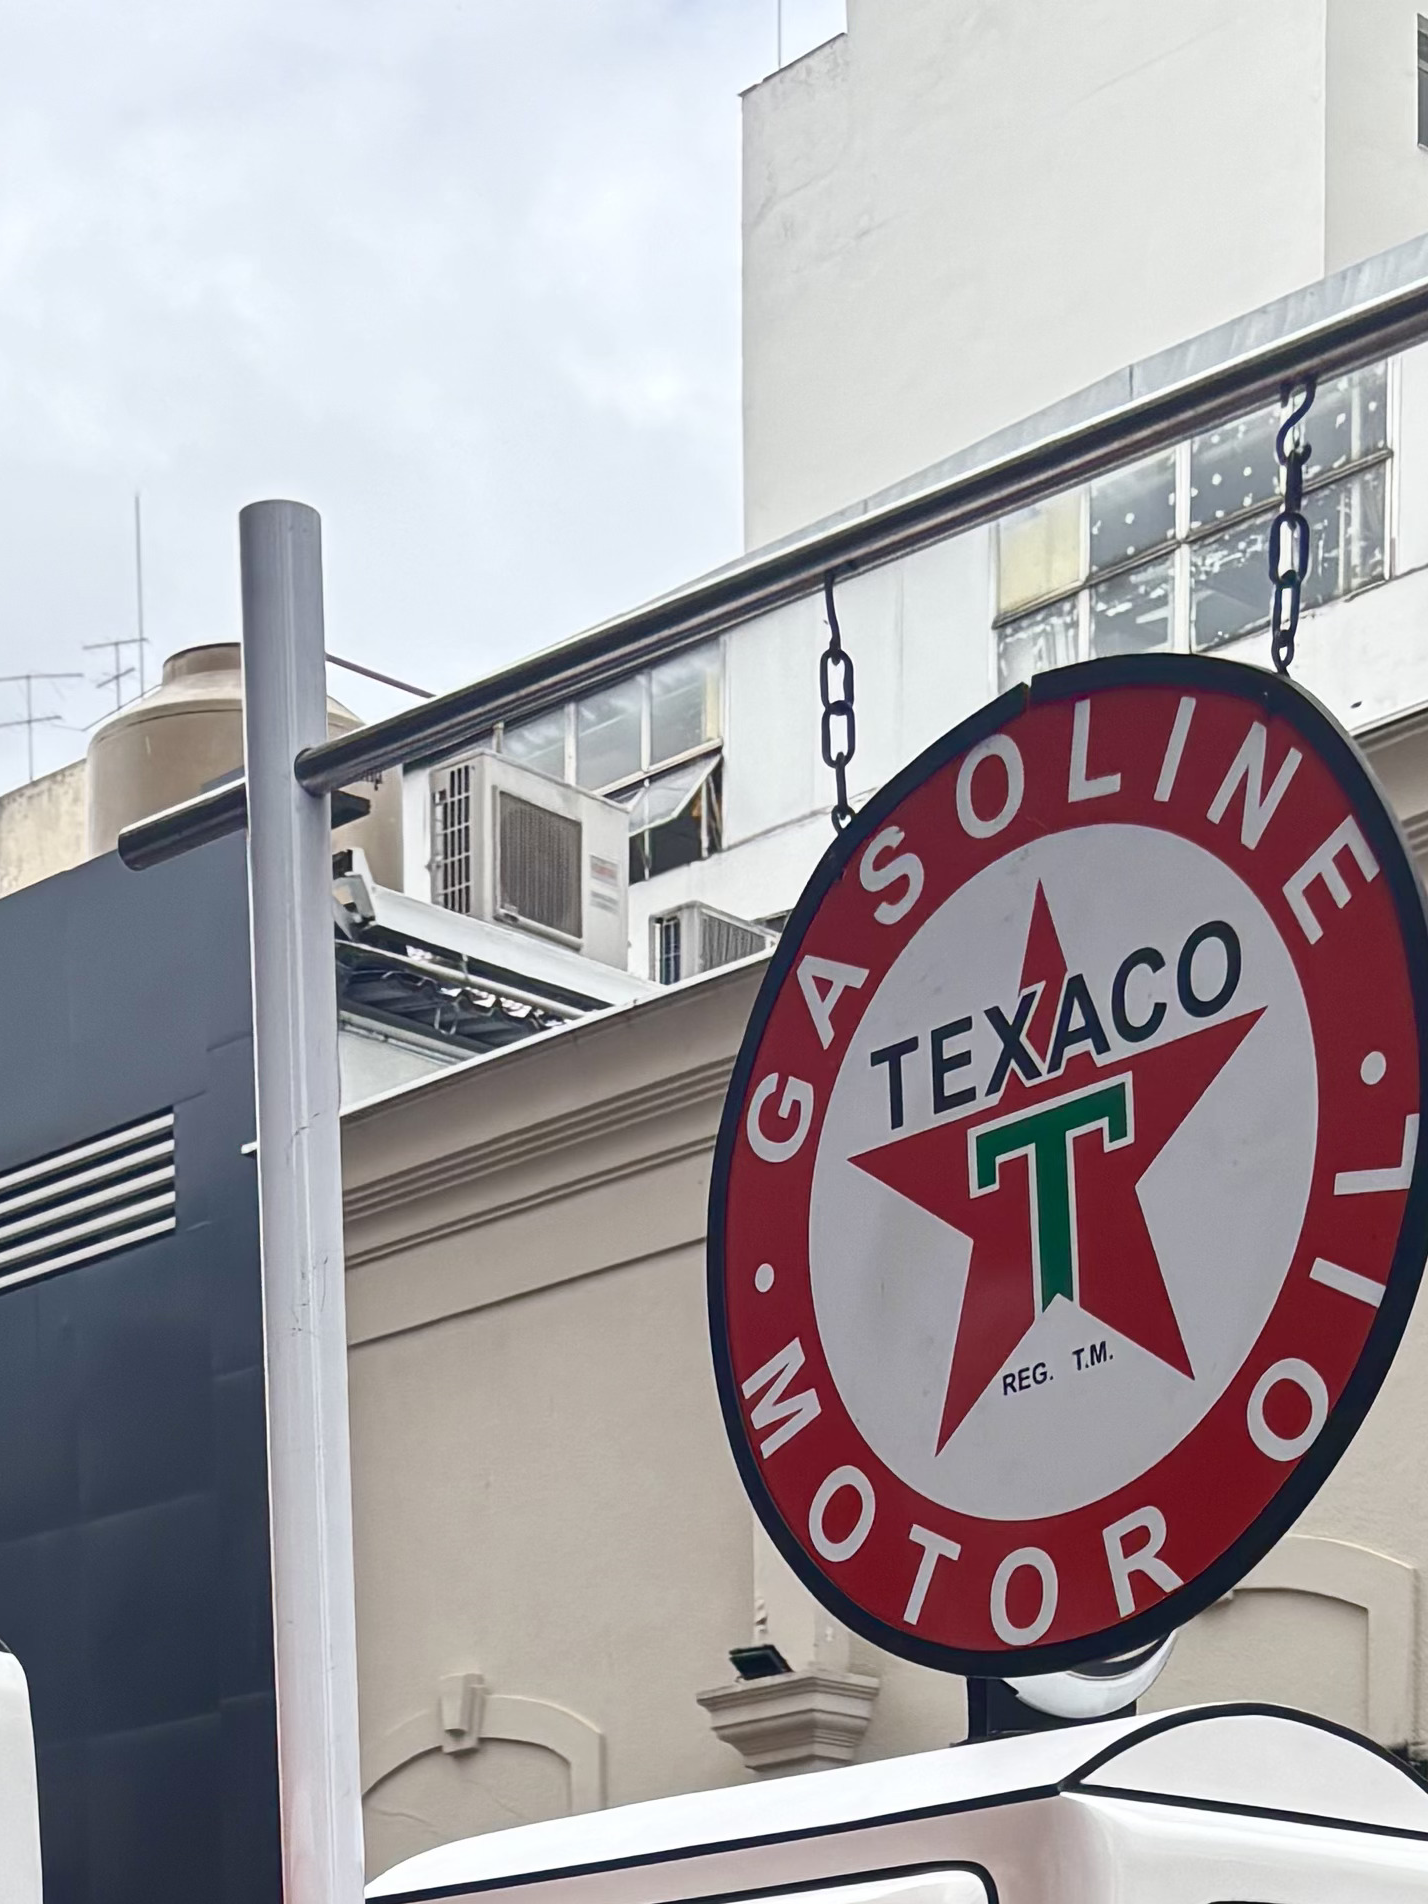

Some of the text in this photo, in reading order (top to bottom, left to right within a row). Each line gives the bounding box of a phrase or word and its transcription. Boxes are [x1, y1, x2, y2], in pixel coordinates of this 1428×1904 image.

[748, 696, 1381, 1163] GASOLINE
[870, 920, 1242, 1128] TEXACO
[741, 1112, 1418, 1646] MOTOR OIL
[1002, 1340, 1114, 1396] REG. T.M.
